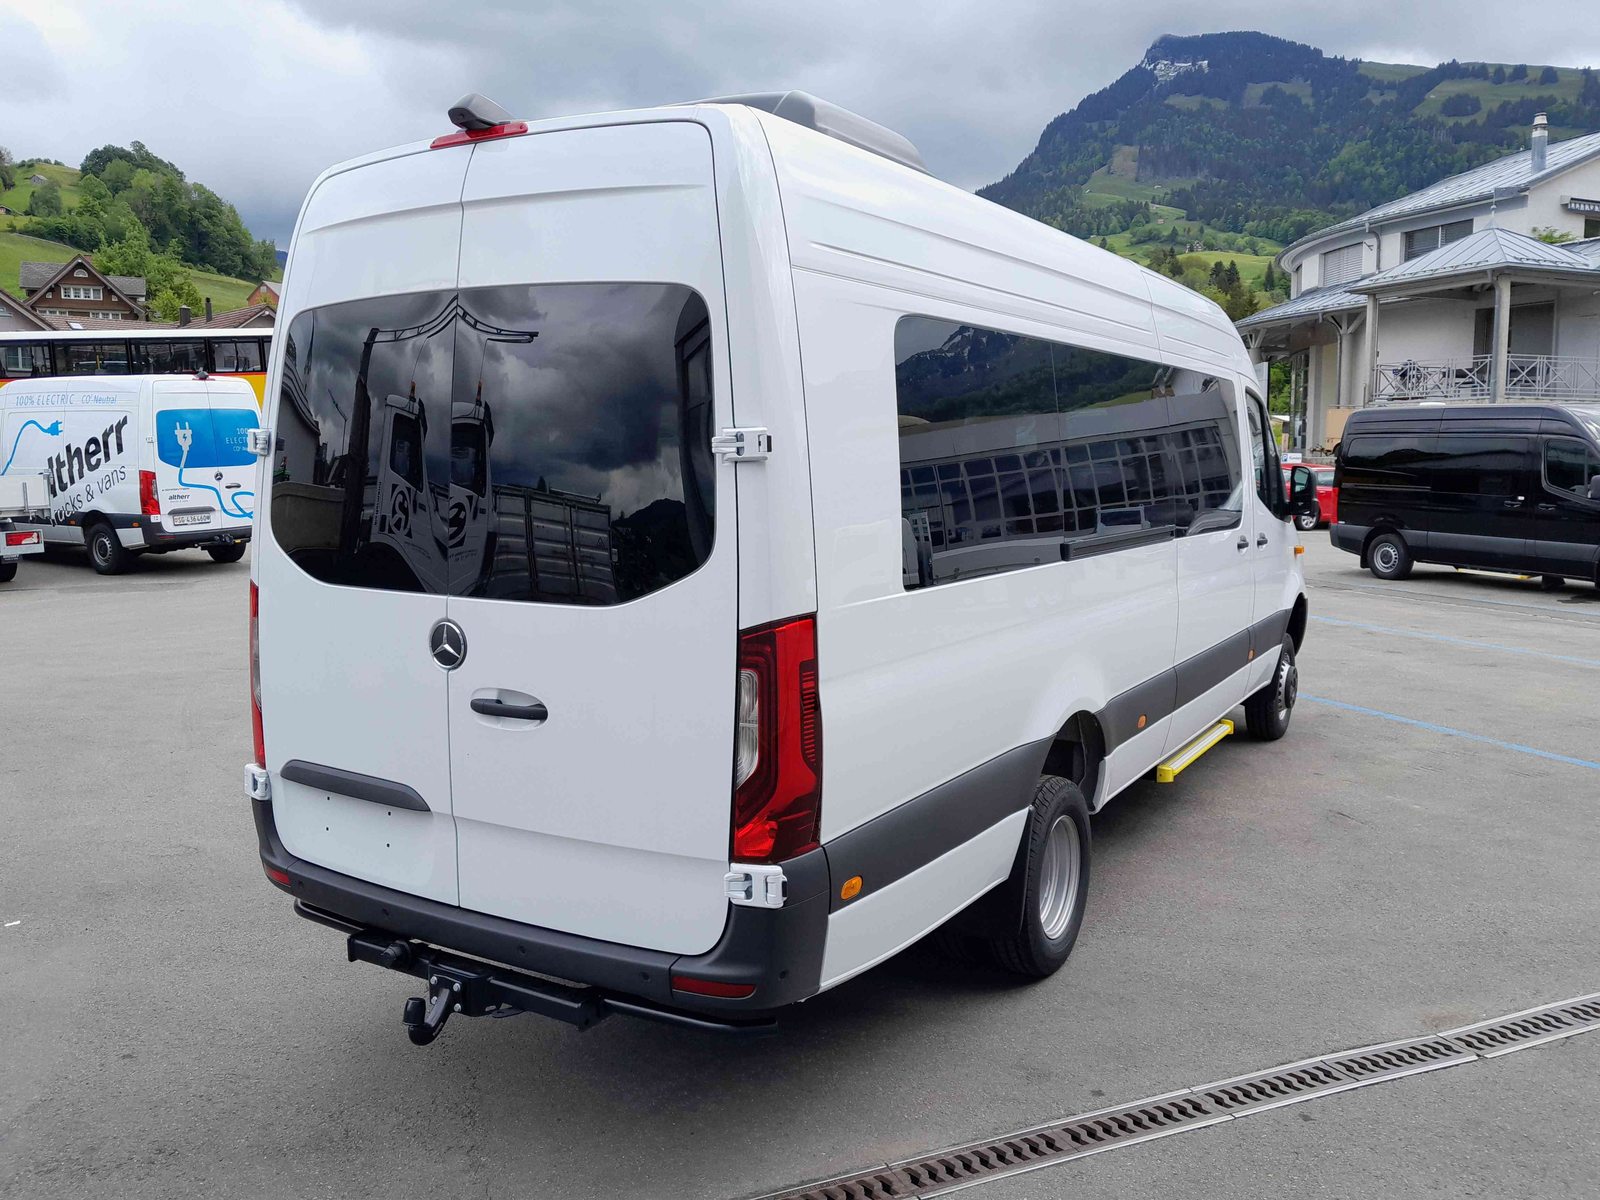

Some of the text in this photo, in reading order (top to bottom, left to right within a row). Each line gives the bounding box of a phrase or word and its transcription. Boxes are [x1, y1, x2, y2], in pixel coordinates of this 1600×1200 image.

[16, 395, 34, 406] 100%
[37, 394, 75, 405] ELECTRIC
[47, 415, 128, 498] ltherr
[85, 484, 95, 502] &
[97, 465, 126, 494] vans
